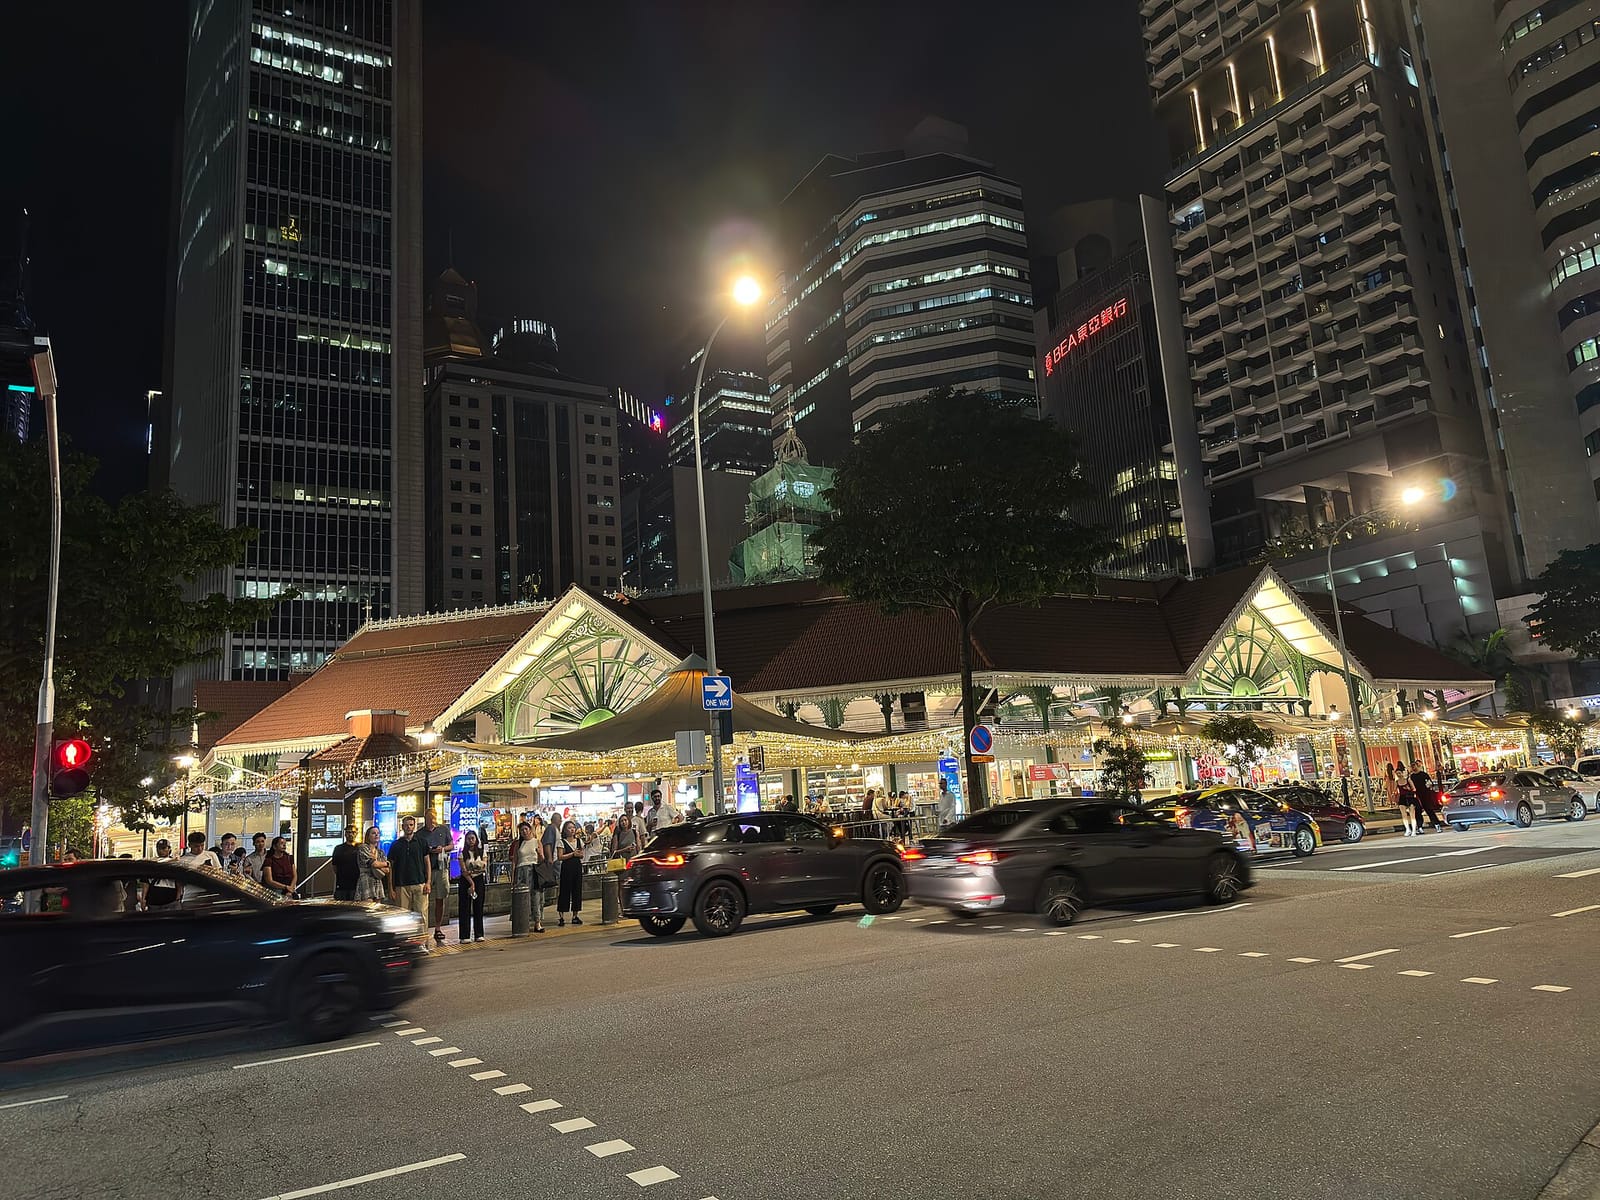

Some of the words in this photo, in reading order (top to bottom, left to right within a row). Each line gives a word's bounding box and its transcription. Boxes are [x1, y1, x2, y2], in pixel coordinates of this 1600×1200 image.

[1053, 334, 1078, 364] BEA
[1077, 298, 1127, 343] 東亞銀行
[705, 699, 717, 707] ONE
[719, 699, 730, 707] WAY
